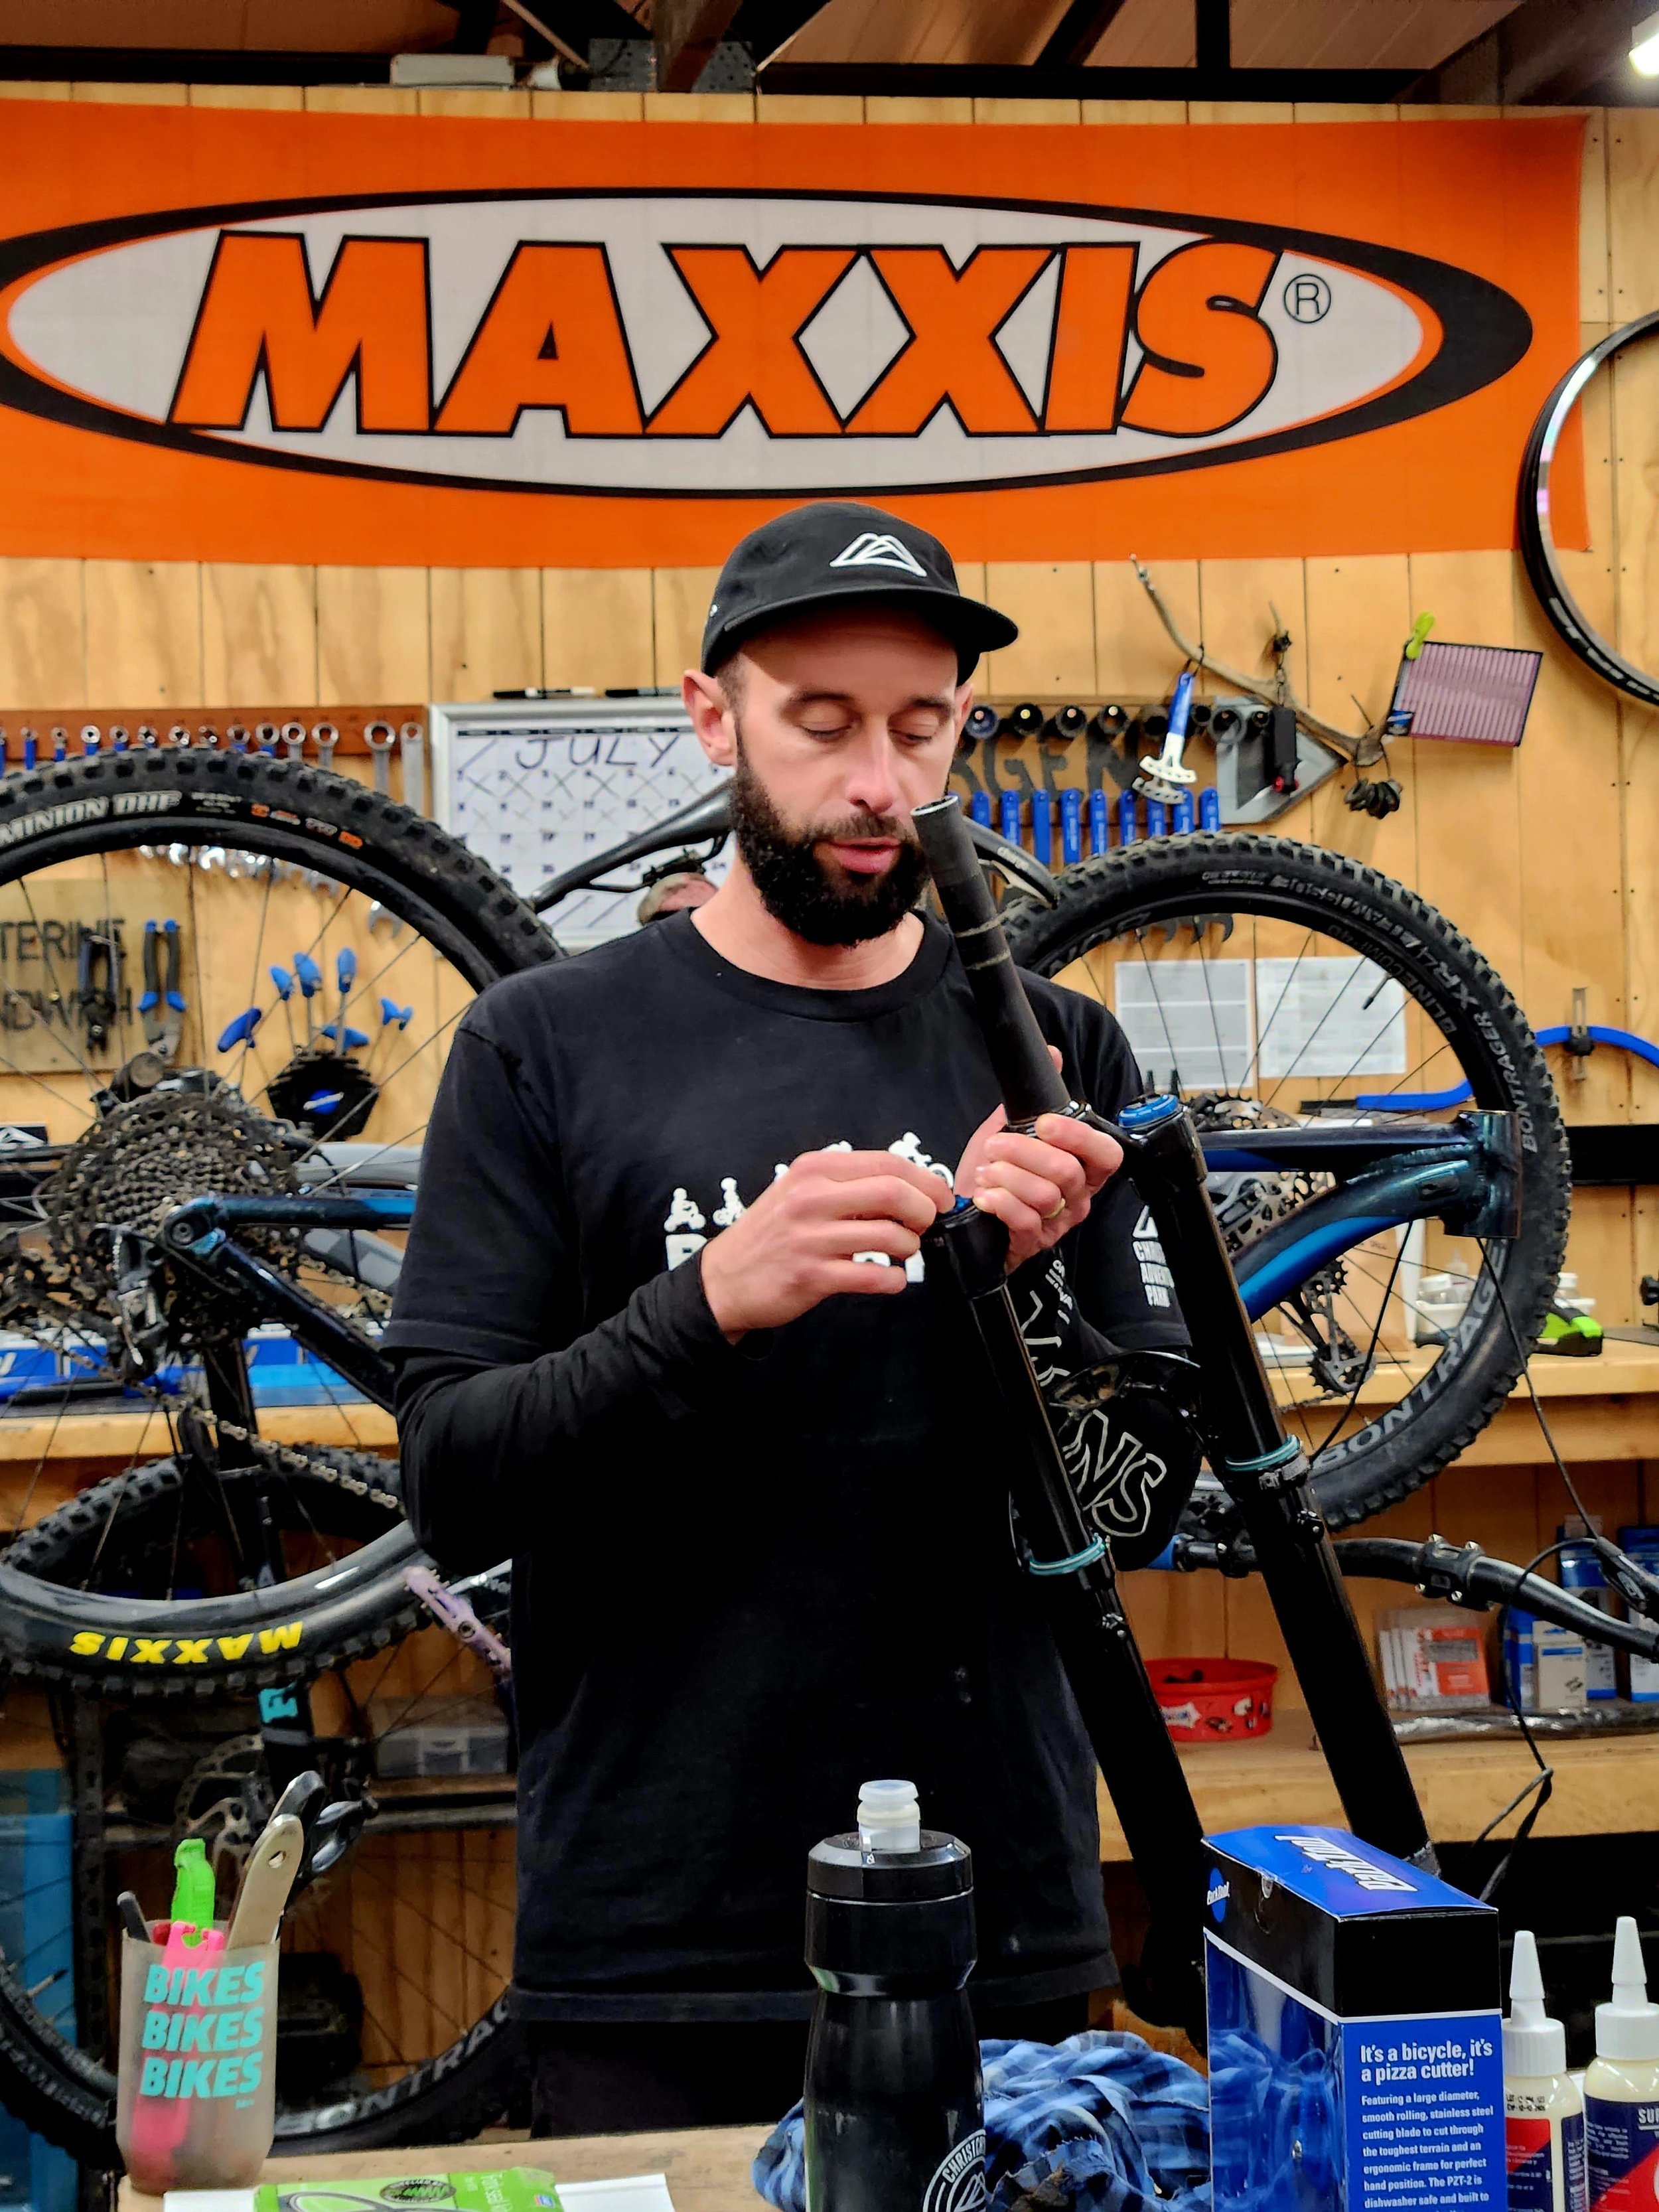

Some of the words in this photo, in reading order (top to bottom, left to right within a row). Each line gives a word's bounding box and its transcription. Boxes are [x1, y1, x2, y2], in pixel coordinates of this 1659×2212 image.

[165, 230, 1282, 437] MAXXIS
[515, 733, 680, 770] JULY
[0, 796, 109, 850] MINION
[1475, 1010, 1538, 1154] BONTRAGER
[70, 1621, 304, 1664] MAXXIS
[143, 1961, 265, 2006] BIKES
[141, 2007, 264, 2052] BIKES
[1360, 2045, 1384, 2063] It's
[1388, 2047, 1398, 2062] a
[1402, 2041, 1466, 2063] bicycle,
[1470, 2039, 1492, 2057] it's
[139, 2051, 263, 2099] BIKES
[1361, 2068, 1372, 2083] a
[1376, 2063, 1417, 2085] pizza
[1421, 2059, 1474, 2079] cutter!
[1361, 2095, 1404, 2106] Featuring
[1413, 2093, 1437, 2104] large
[1439, 2091, 1480, 2102] diameter,
[1362, 2110, 1394, 2123] smooth
[1396, 2109, 1429, 2122] rolling,
[1430, 2106, 1470, 2119] stainless
[1472, 2105, 1494, 2116] steel
[1362, 2130, 1394, 2141] cutting
[1396, 2126, 1421, 2138] blade
[1423, 2126, 1431, 2136] to
[1433, 2125, 1449, 2136] cut
[1450, 2123, 1484, 2136] through
[1362, 2147, 1378, 2157] the
[1379, 2144, 1418, 2157] toughest
[1419, 2142, 1450, 2154] terrain
[1451, 2141, 1468, 2151] and
[1470, 2142, 1482, 2151] an
[1363, 2162, 1411, 2176] ergonomic
[1413, 2160, 1439, 2172] frame
[1440, 2159, 1453, 2170] for
[1455, 2158, 1487, 2171] perfect
[1364, 2179, 1386, 2191] hand
[1388, 2177, 1427, 2193] position.
[1428, 2176, 1446, 2188] The
[1447, 2174, 1473, 2186] PZT-2
[1474, 2175, 1482, 2185] is
[1364, 2195, 1417, 2209] dishwasher
[1418, 2193, 1439, 2205] safe
[1440, 2193, 1457, 2203] and
[1458, 2191, 1479, 2203] built
[1480, 2192, 1490, 2201] to
